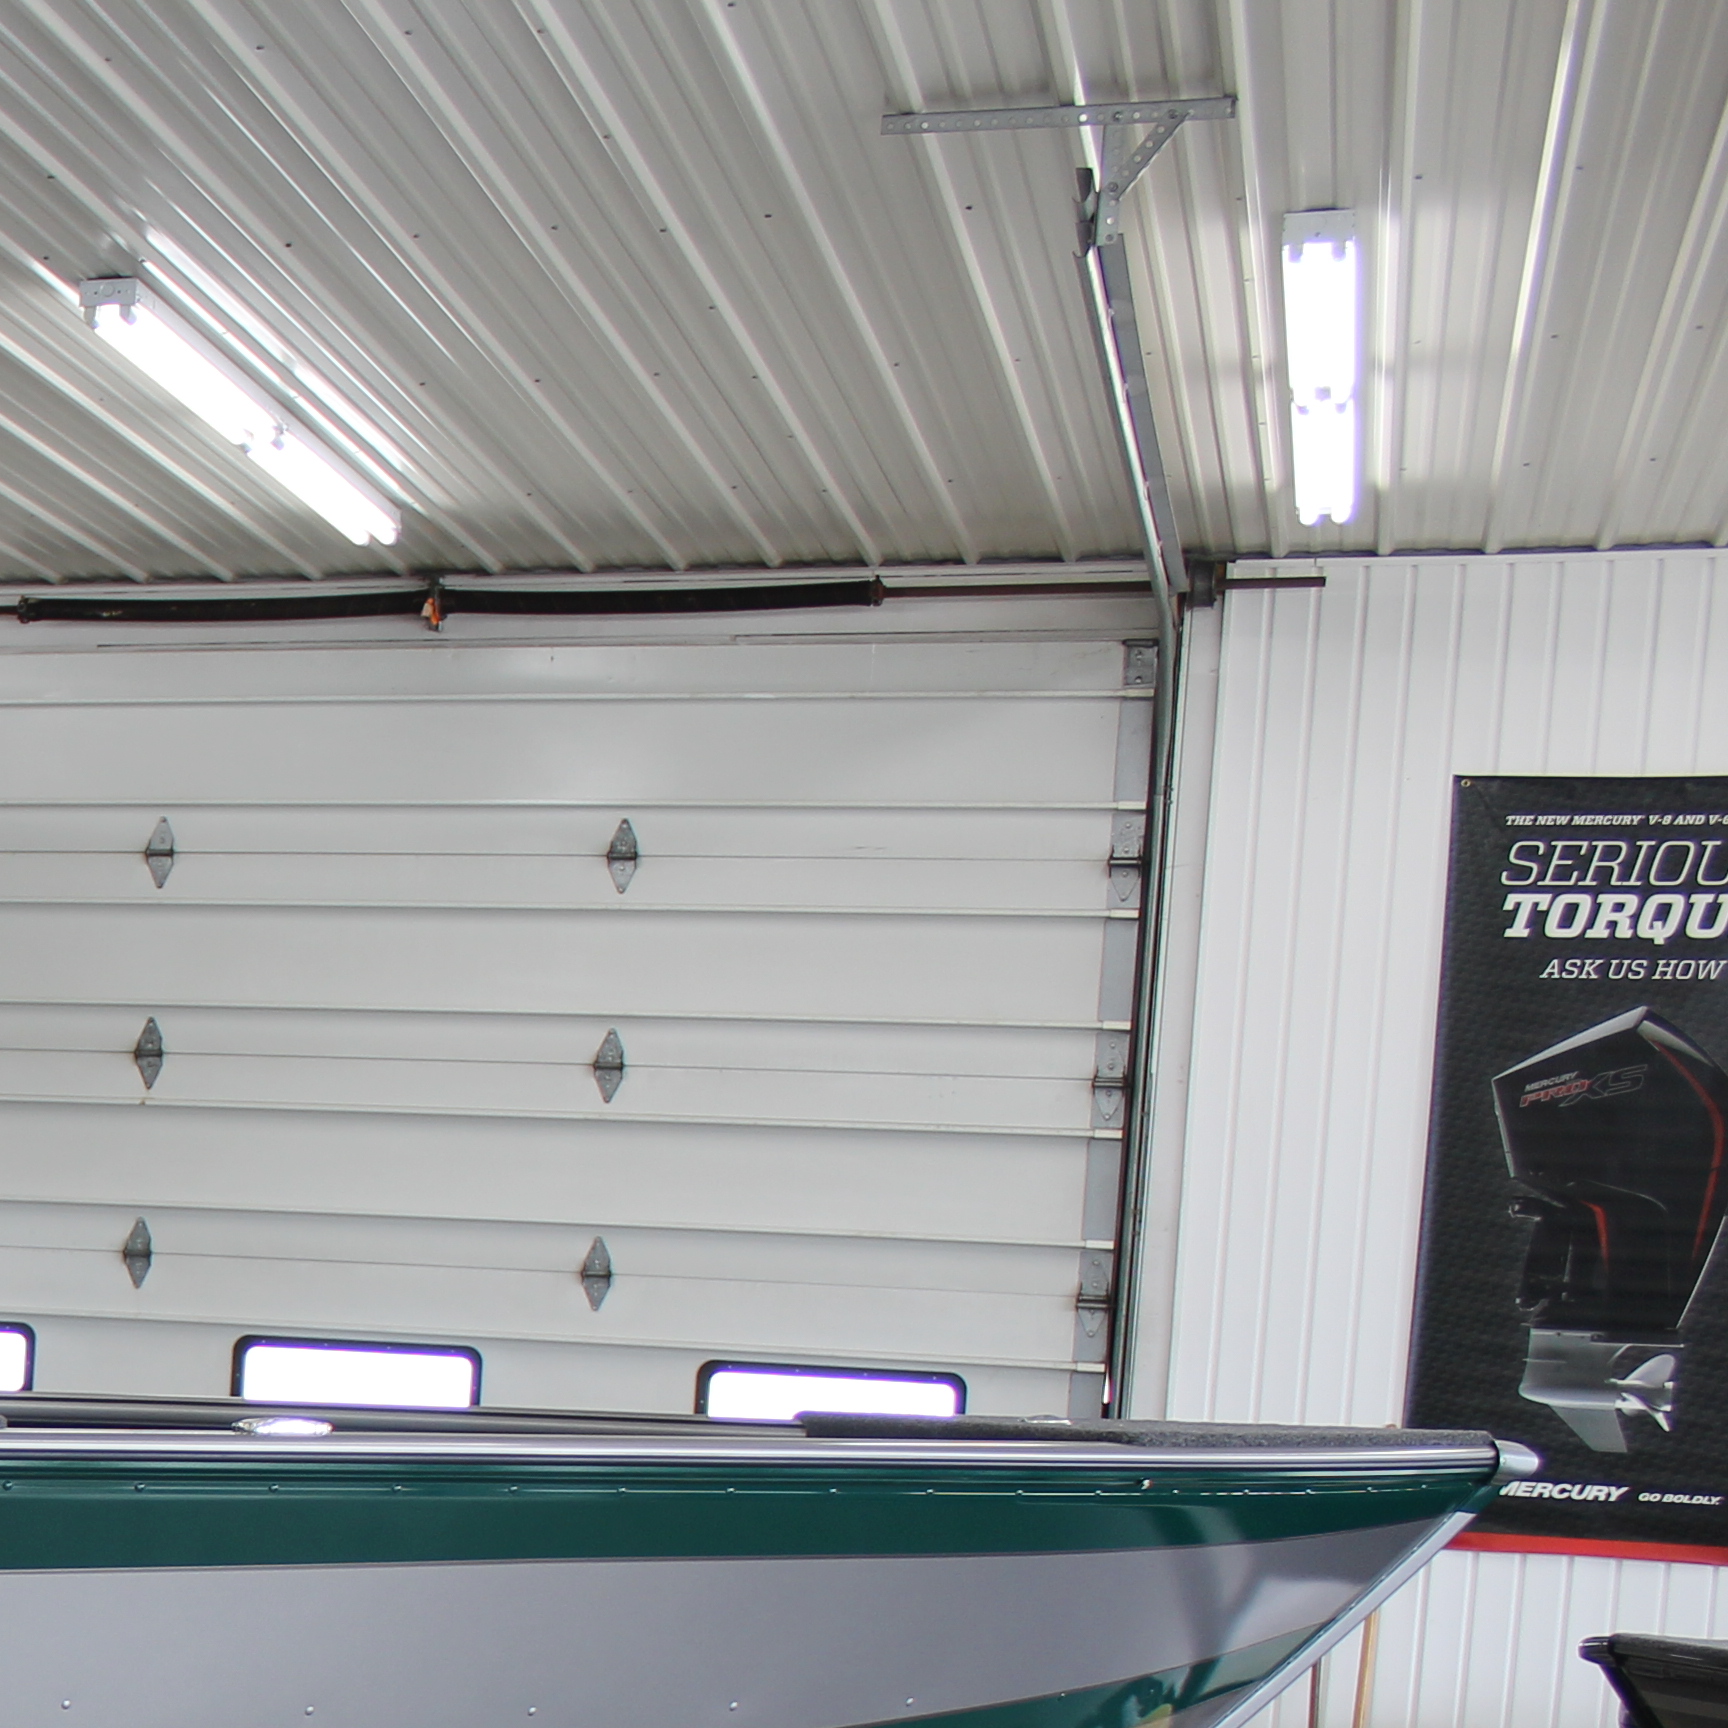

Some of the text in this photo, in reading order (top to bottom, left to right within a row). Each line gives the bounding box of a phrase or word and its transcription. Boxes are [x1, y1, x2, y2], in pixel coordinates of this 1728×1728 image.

[1506, 815, 1534, 825] THE
[1535, 815, 1571, 825] NEW
[1571, 815, 1644, 825] MERCURY
[1672, 815, 1706, 826] AND
[1502, 893, 1728, 945] TORQU
[1539, 959, 1726, 980] ASK US HOW
[1524, 1071, 1580, 1092] MERCURY
[1638, 1492, 1661, 1502] GO
